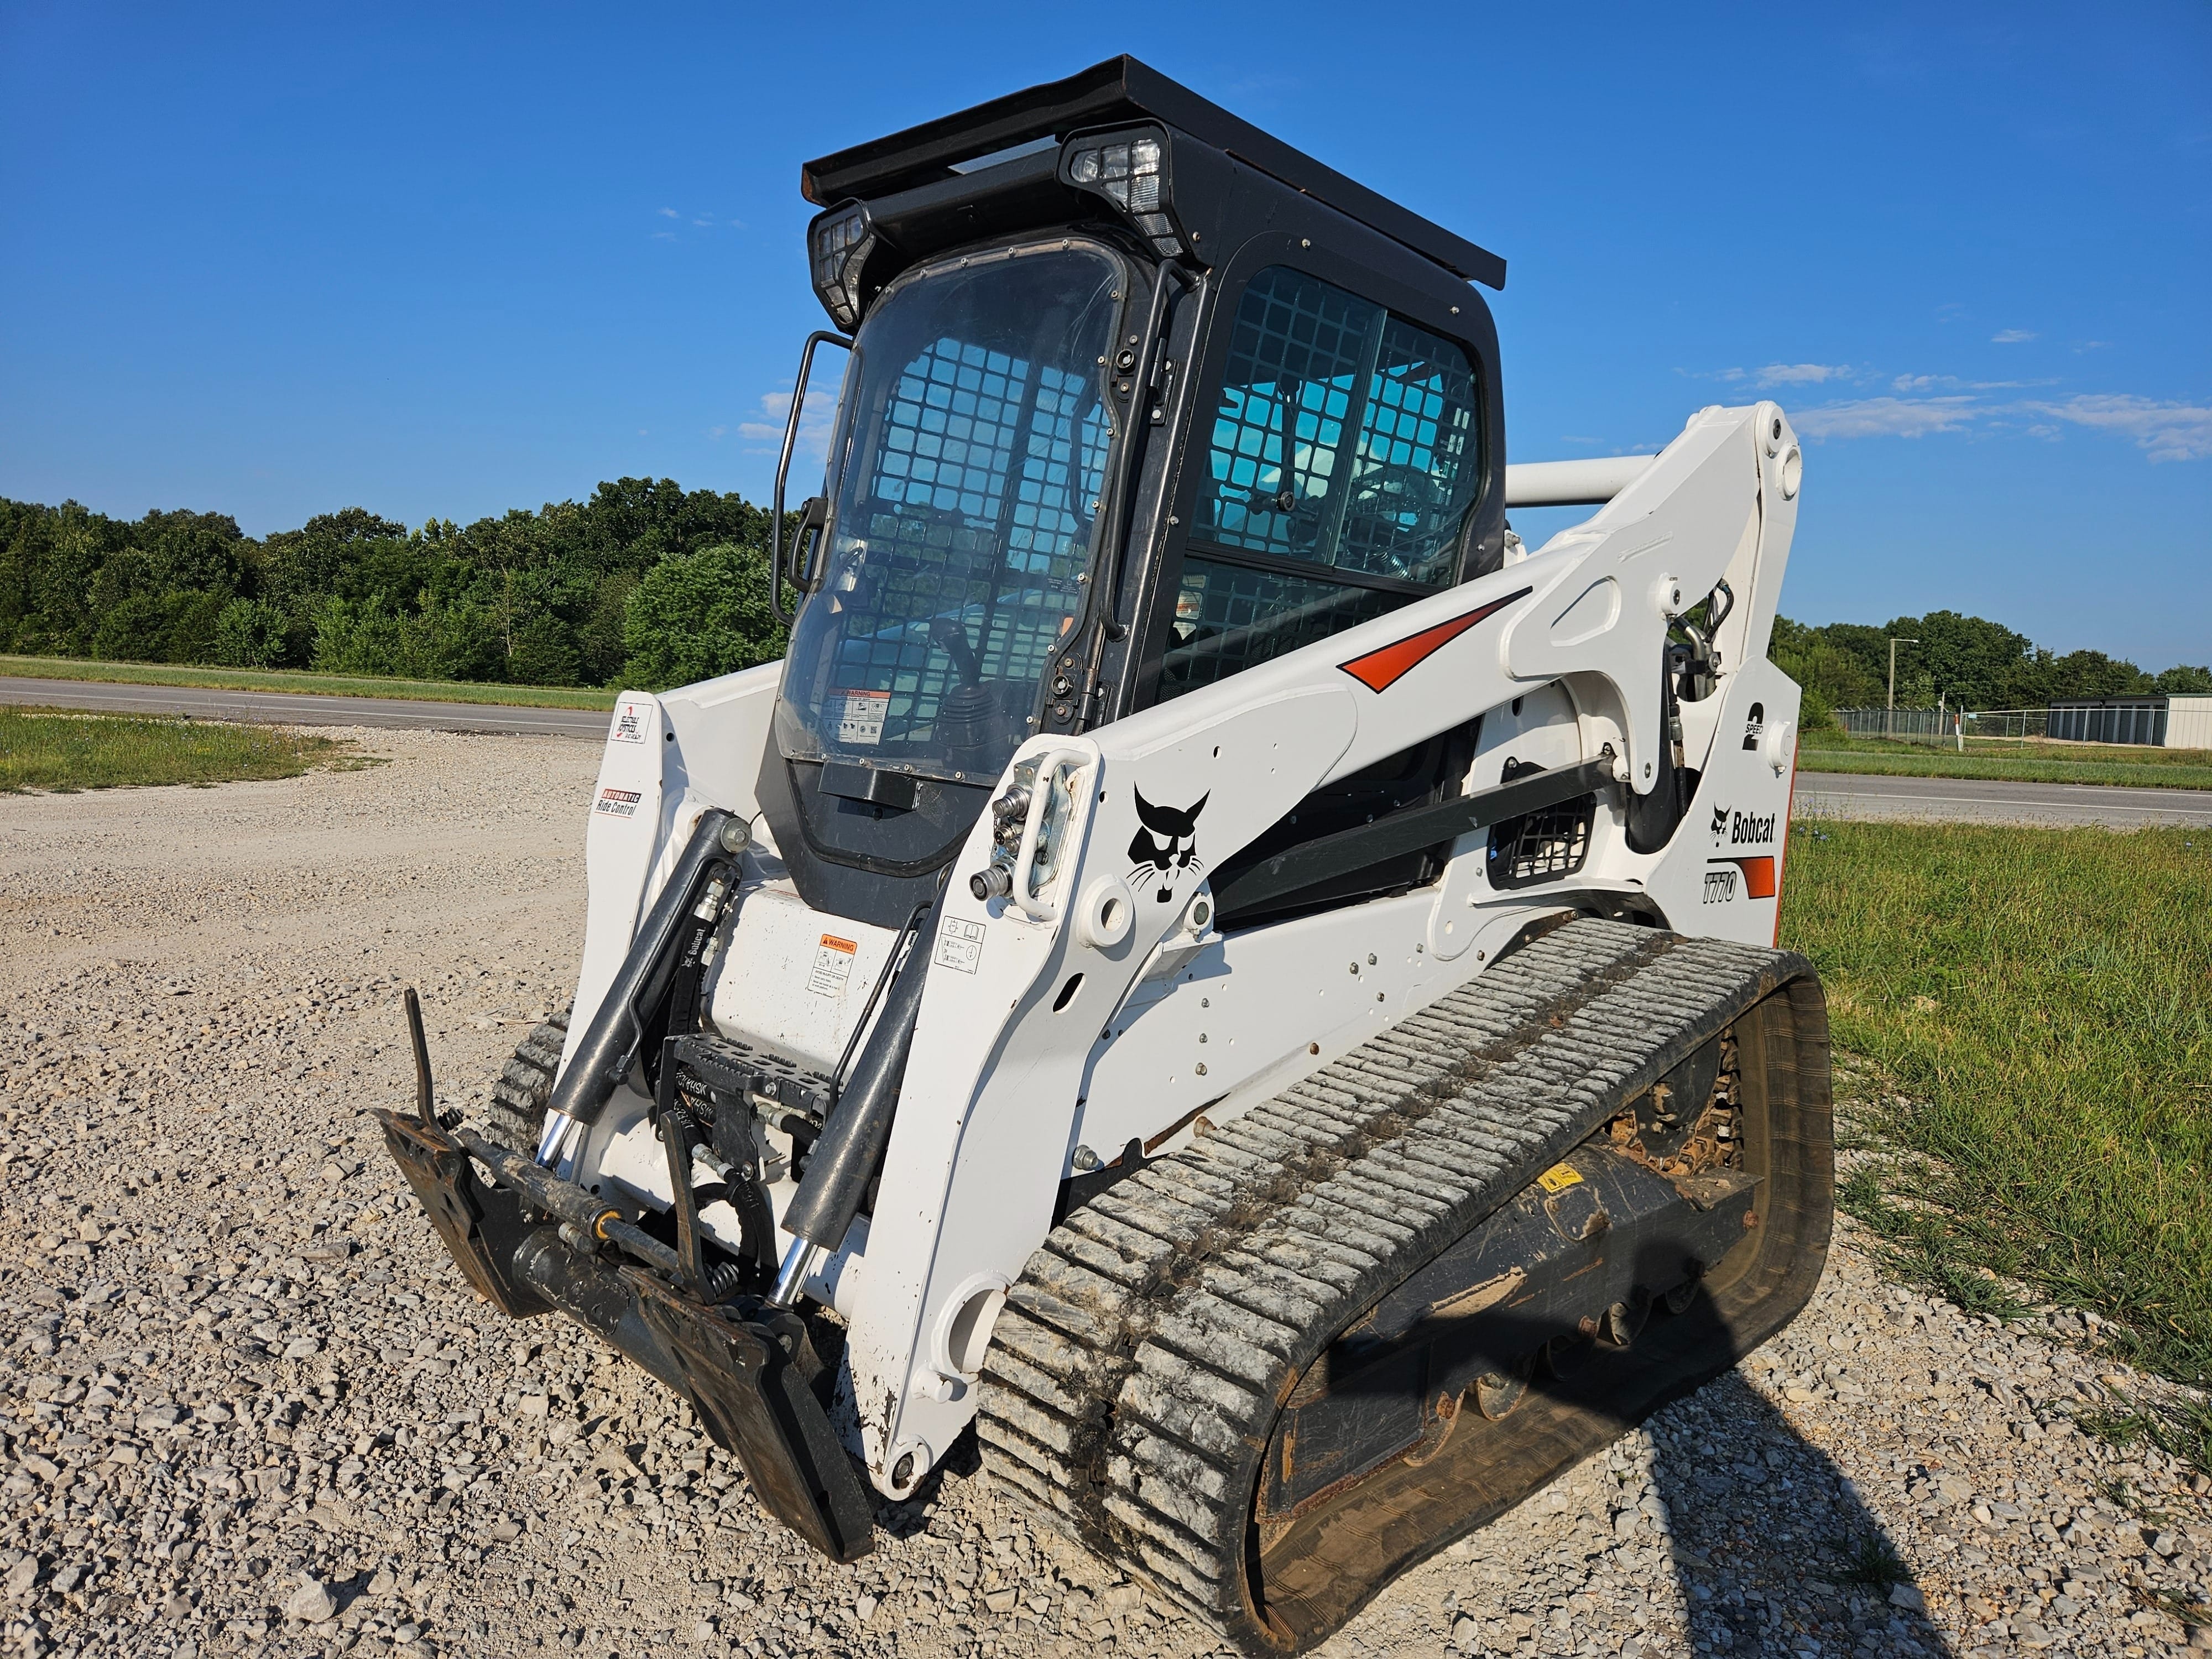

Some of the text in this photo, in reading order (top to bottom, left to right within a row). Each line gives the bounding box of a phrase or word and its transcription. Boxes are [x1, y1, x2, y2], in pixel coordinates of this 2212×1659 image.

[1742, 702, 1764, 751] 2
[1746, 723, 1764, 734] SPEED
[602, 790, 640, 802] AUTOMATIC
[596, 800, 637, 816] Ride Control
[1731, 811, 1775, 843] Bobcat
[1703, 871, 1737, 904] T770
[829, 939, 854, 951] WARNING
[690, 1097, 713, 1119] MSHA
